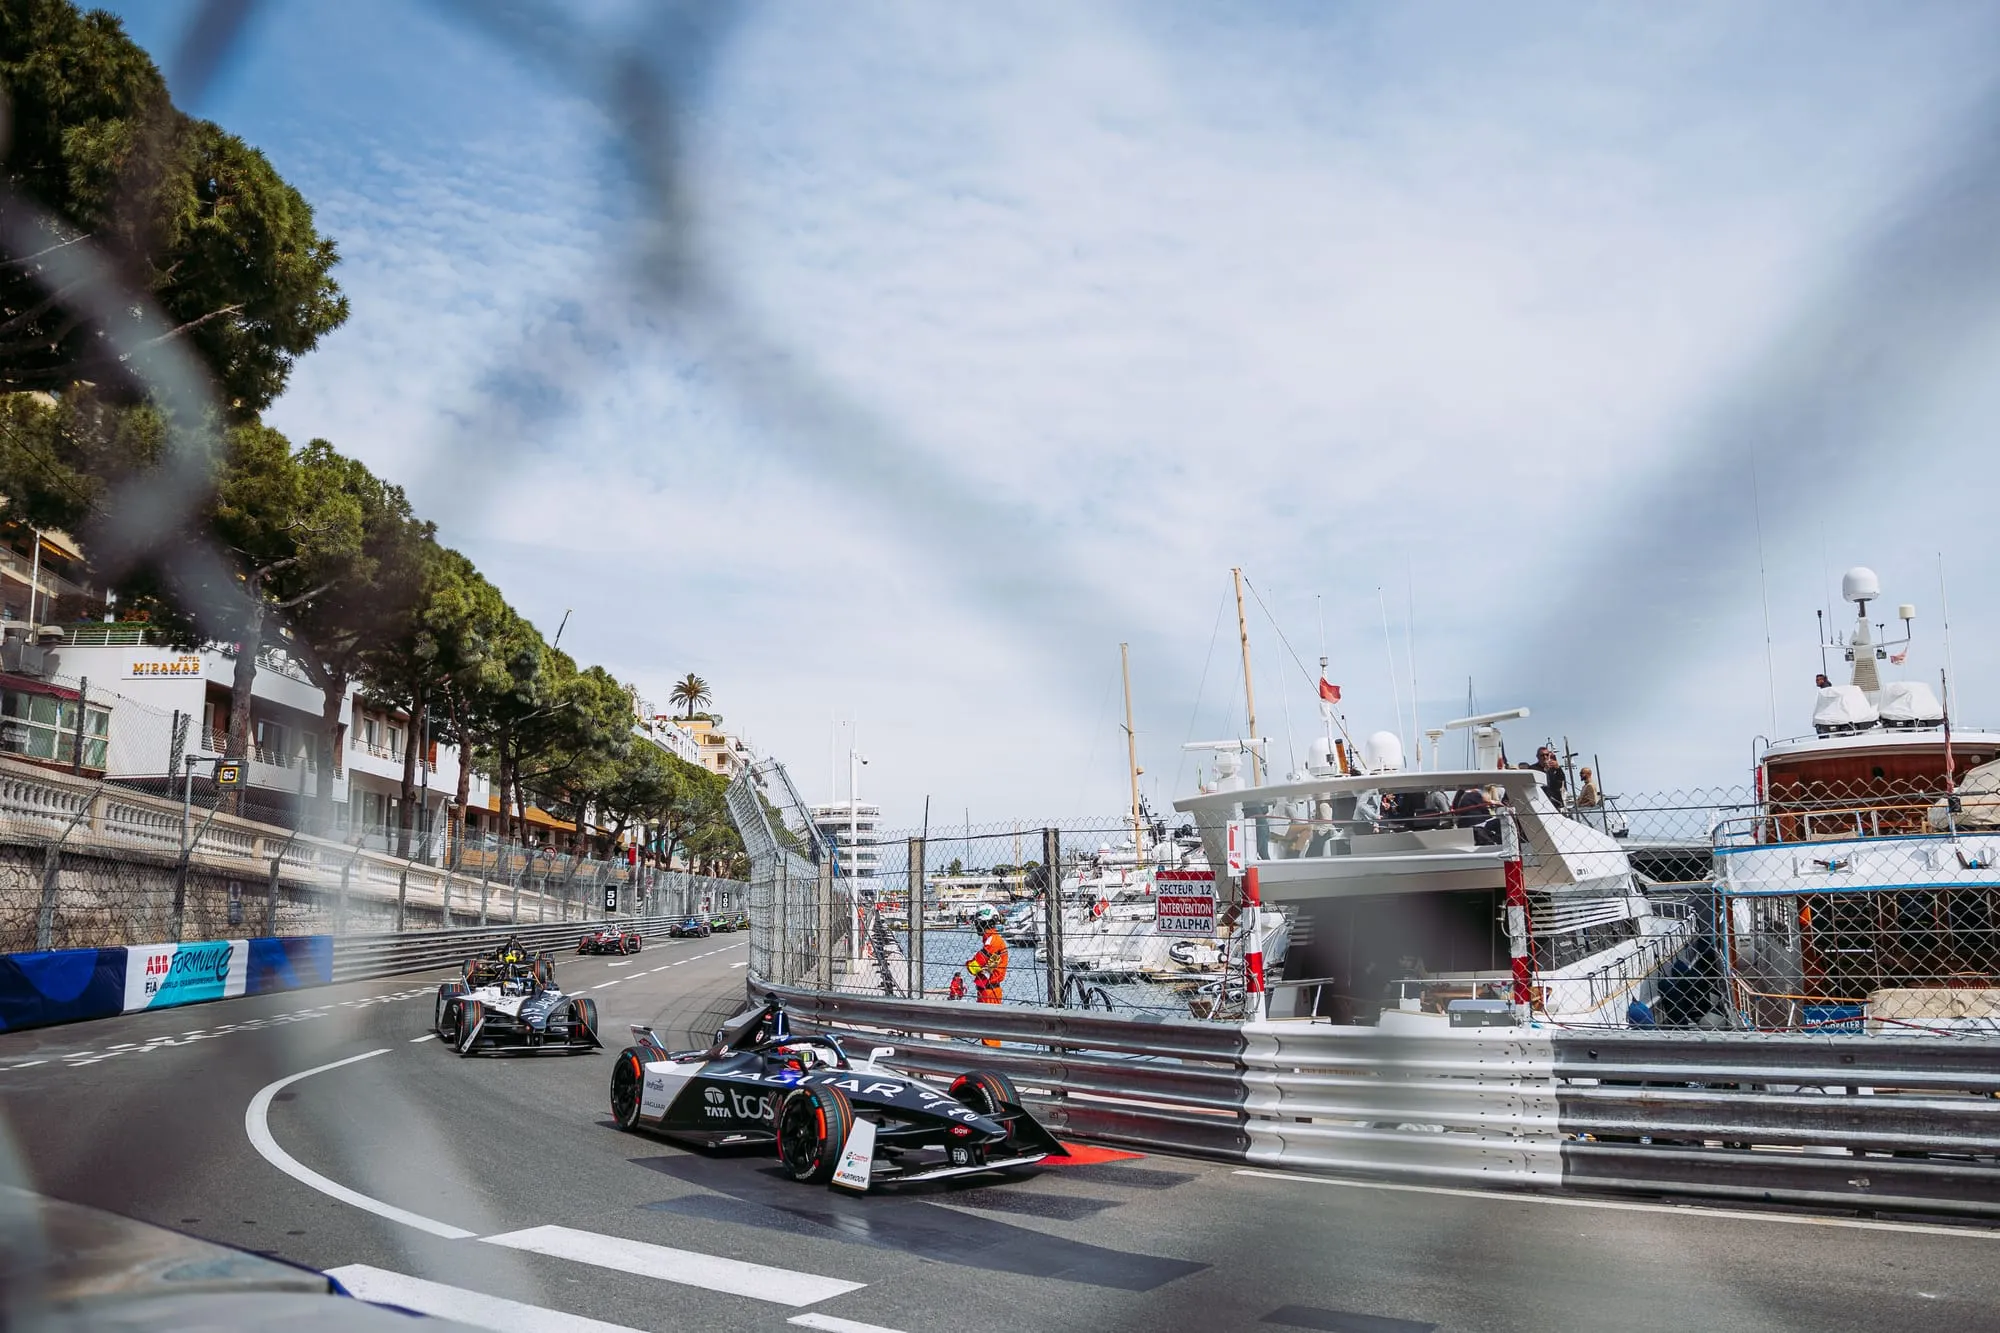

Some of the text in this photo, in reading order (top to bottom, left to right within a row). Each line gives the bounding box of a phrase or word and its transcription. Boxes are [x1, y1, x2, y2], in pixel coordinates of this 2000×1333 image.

[133, 663, 200, 673] MIRAMAR
[223, 770, 235, 780] SC
[1160, 884, 1211, 895] SECTEUR 12
[607, 890, 616, 907] 50
[1160, 903, 1212, 914] INTERVENTION
[1160, 918, 1211, 930] 12 ALPHA
[146, 955, 168, 975] ABB
[170, 949, 219, 976] FORMULA
[1821, 1020, 1860, 1029] HARTER
[703, 1070, 905, 1098] JAGUAR
[643, 1101, 665, 1110] JAGUAR
[704, 1106, 732, 1118] TATA
[953, 1150, 966, 1161] FIA
